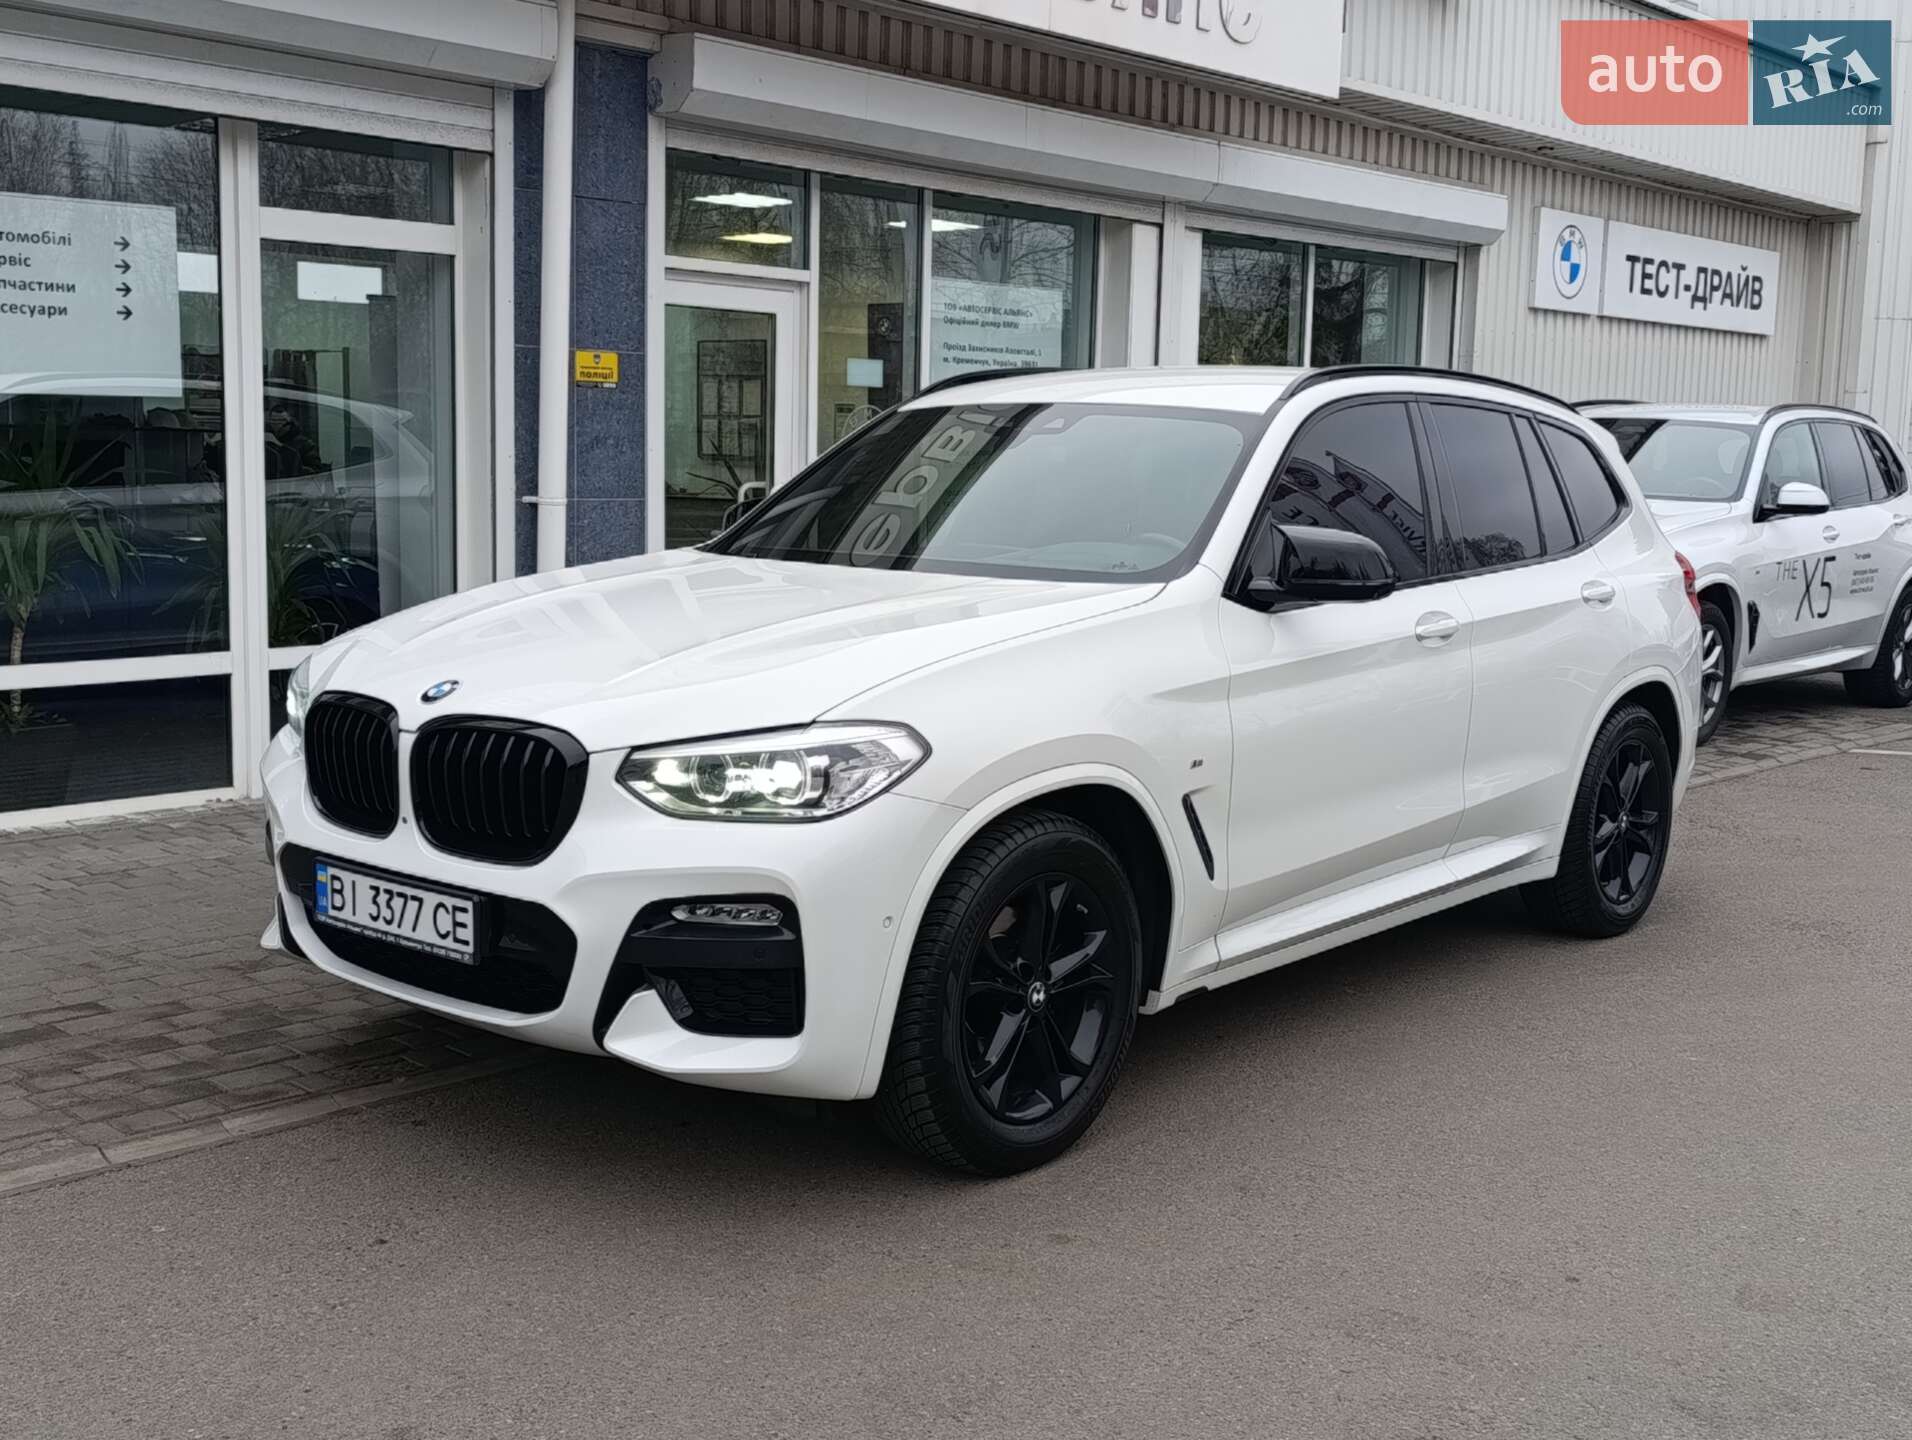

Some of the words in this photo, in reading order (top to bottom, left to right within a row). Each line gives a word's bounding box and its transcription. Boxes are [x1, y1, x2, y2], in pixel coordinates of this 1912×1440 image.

[1559, 229, 1585, 248] BMW
[1626, 254, 1764, 311] ТЕСТ-ДРАЙВ
[1776, 560, 1799, 582] THE
[1795, 556, 1837, 622] X5
[368, 885, 424, 933] 3377
[433, 902, 470, 947] CE
